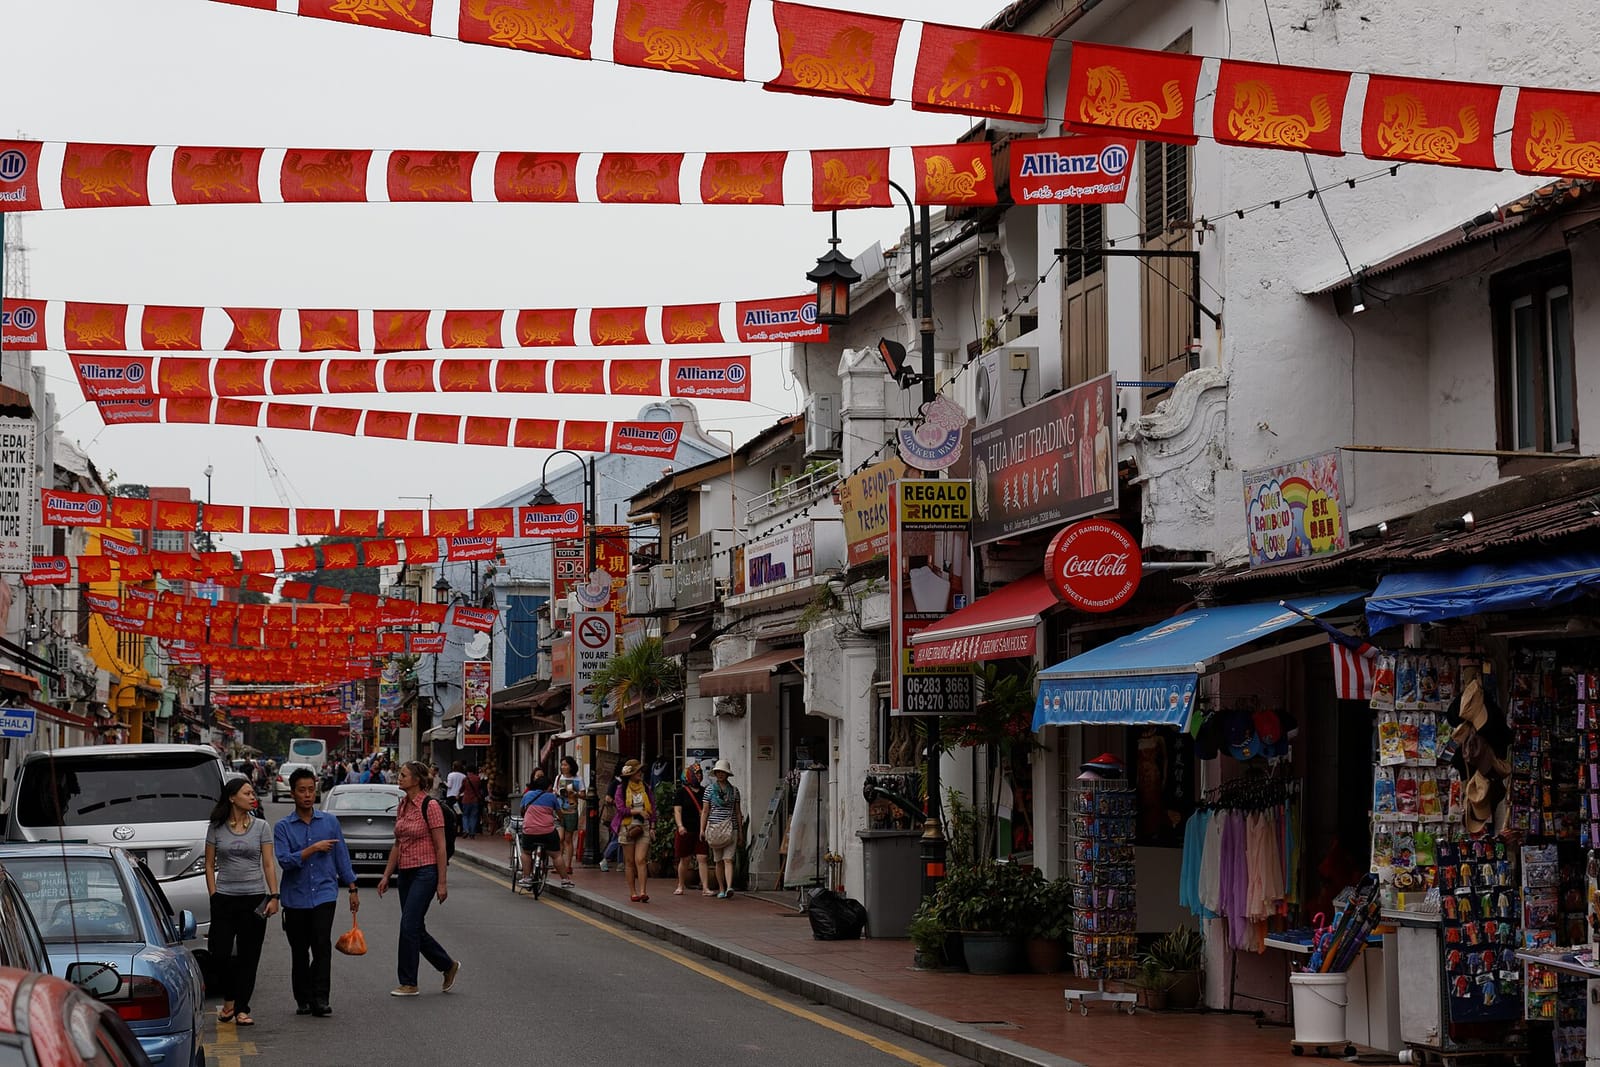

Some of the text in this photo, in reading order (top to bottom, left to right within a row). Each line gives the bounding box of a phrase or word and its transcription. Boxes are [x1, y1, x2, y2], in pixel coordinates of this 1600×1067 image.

[1021, 154, 1098, 176] Allianz
[745, 310, 798, 326] Allianz
[80, 364, 123, 379] Allianz
[677, 367, 724, 380] Allianz
[618, 427, 660, 440] Allianz
[903, 434, 935, 459] JONKER
[938, 434, 957, 455] WALK
[988, 440, 1007, 473] HUA
[1009, 431, 1026, 465] MEI
[1029, 413, 1075, 458] TRADING
[0, 450, 26, 464] NTIK
[904, 485, 967, 500] REGALO
[48, 498, 86, 511] Allianz
[1259, 491, 1281, 512] SWEET
[525, 513, 563, 524] Allianz
[922, 504, 968, 519] HOTEL
[1254, 510, 1290, 532] RAINBOW
[1061, 525, 1131, 552] SWEET RAINBOW HOUSE
[557, 561, 574, 574] 5D
[1062, 553, 1130, 578] Coca-Cola
[1063, 581, 1133, 607] SWEET RAINBOW HOUSE
[458, 609, 484, 619] Allianz
[580, 651, 609, 660] YOU ARE
[582, 661, 607, 670] NOW IN
[578, 672, 591, 680] THE
[945, 677, 970, 693] 3663
[947, 694, 970, 710] 3663
[1063, 687, 1167, 712] SWEET RAINBOW HOUSE
